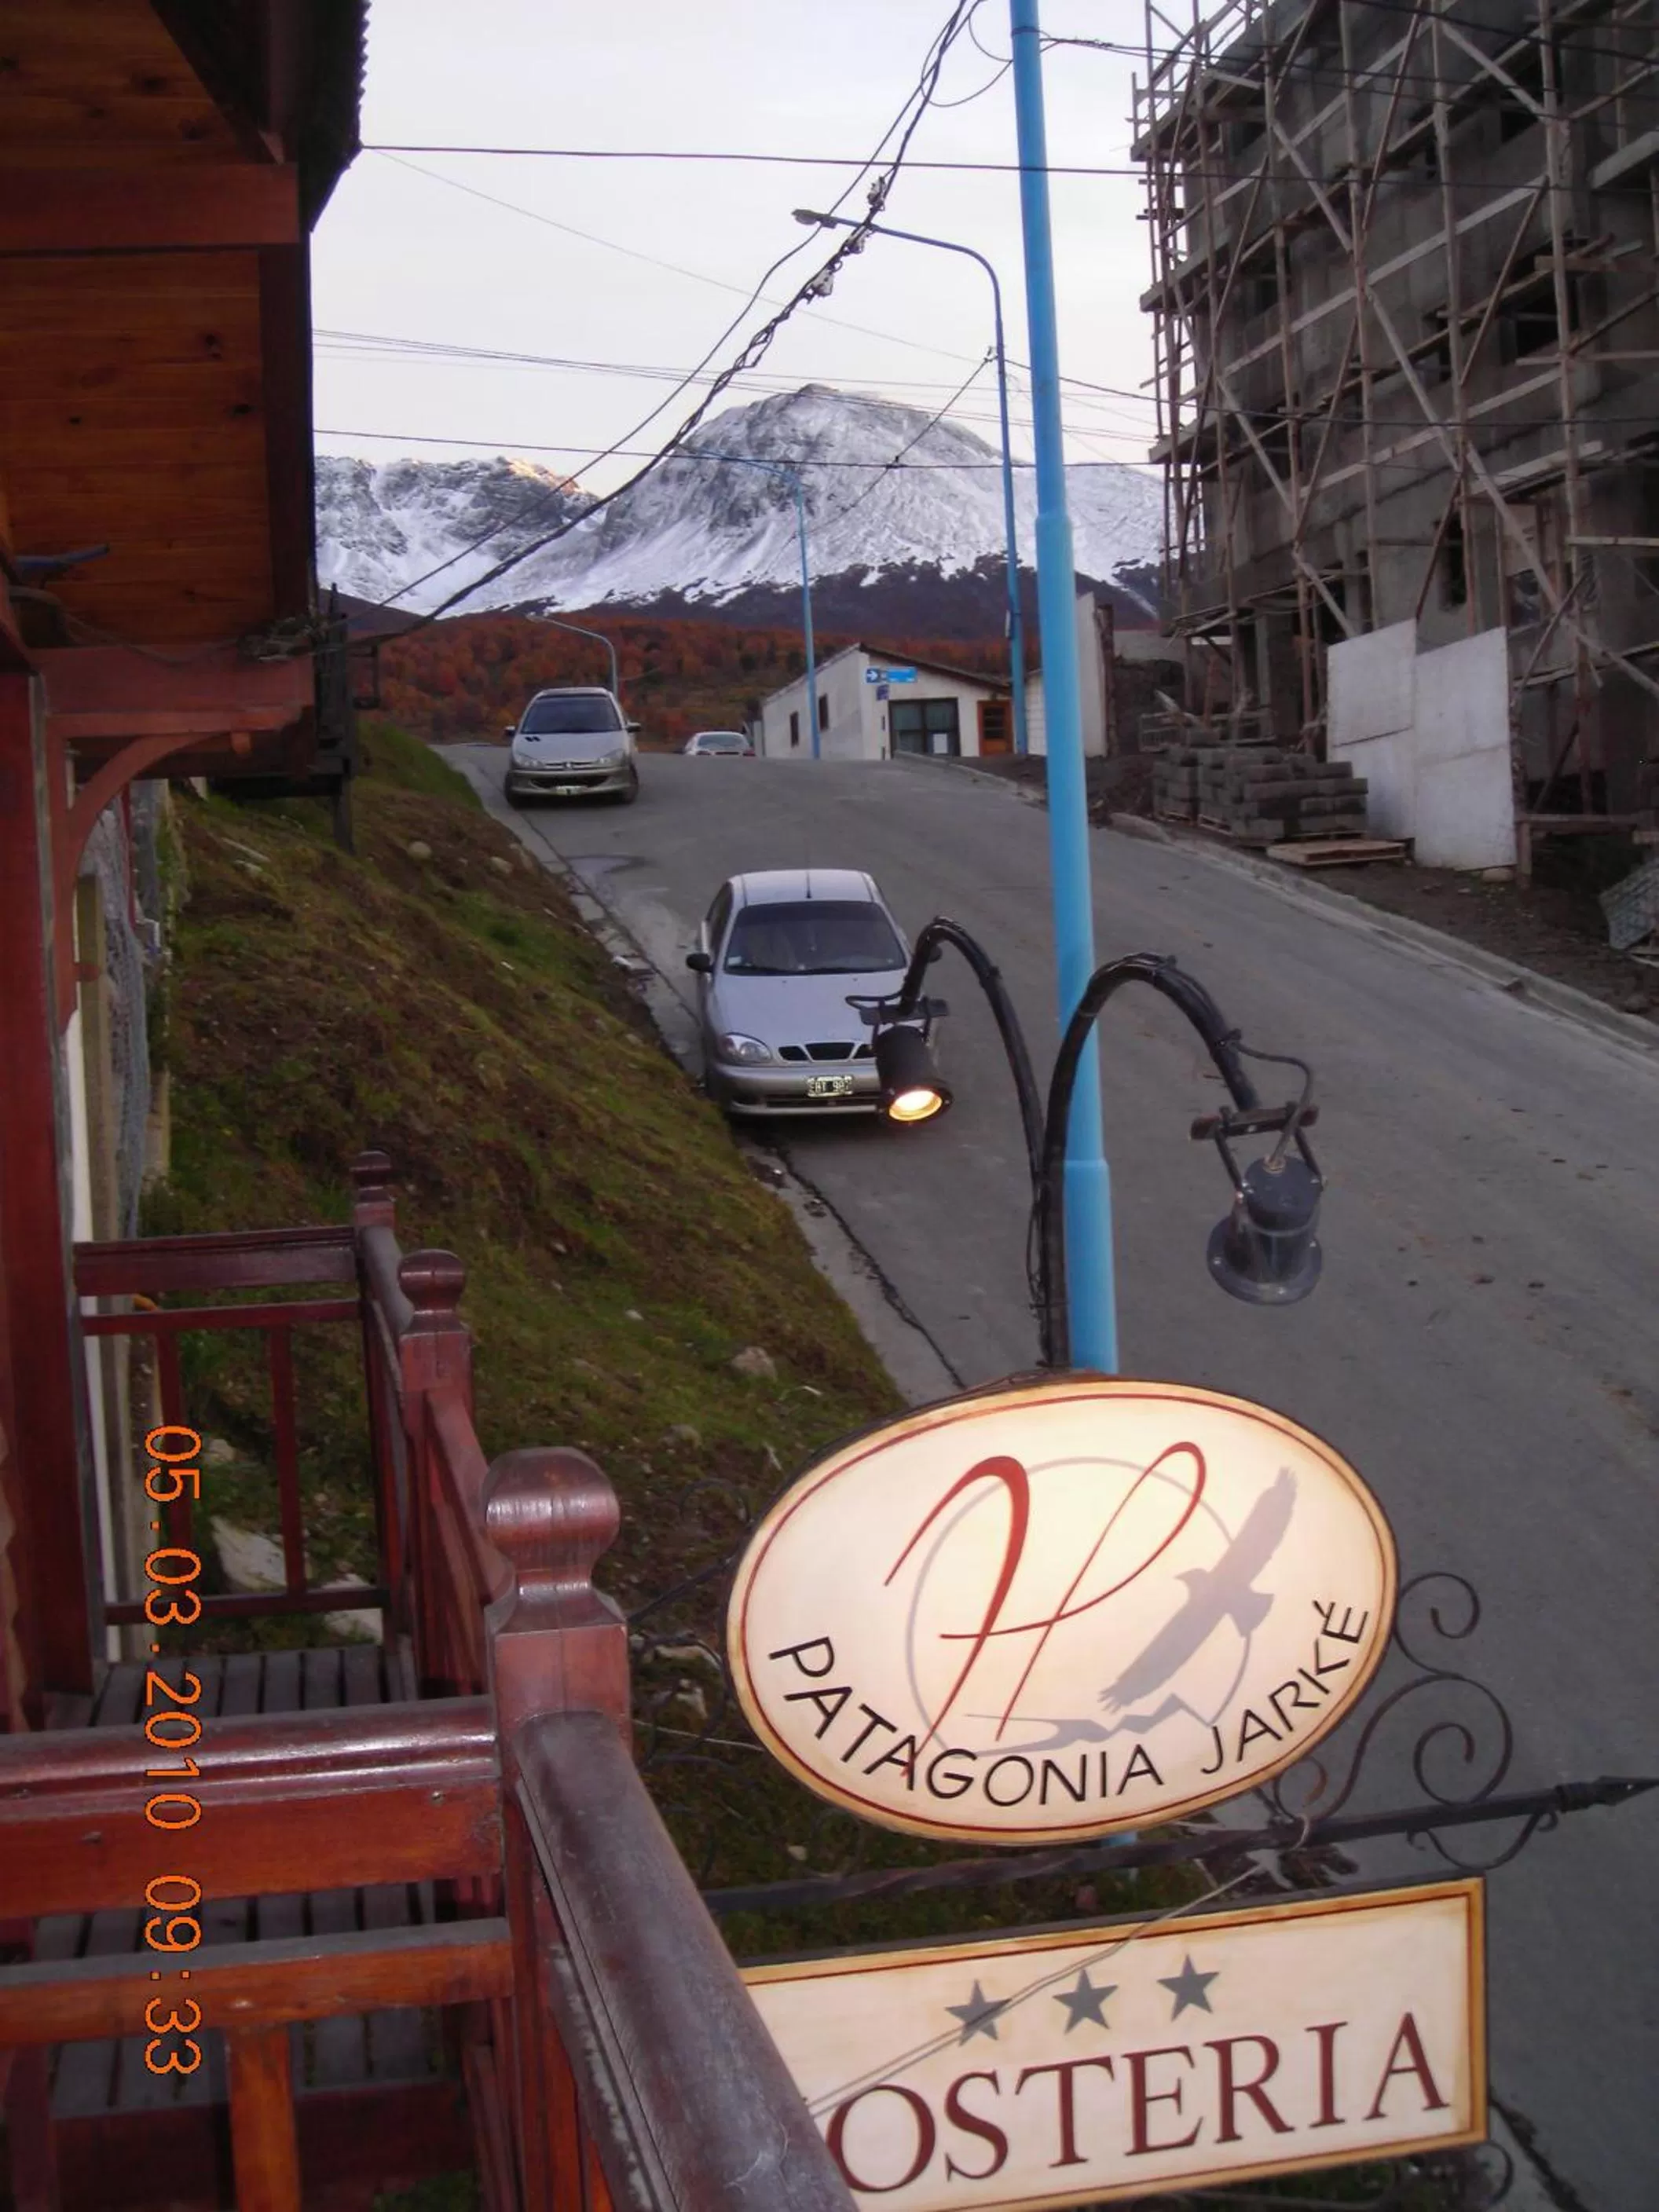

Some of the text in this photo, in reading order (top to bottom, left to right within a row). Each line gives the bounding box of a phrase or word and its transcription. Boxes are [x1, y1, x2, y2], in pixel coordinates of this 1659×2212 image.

[767, 1600, 1369, 1807] PATAGONIA JARKÉ
[825, 2011, 1451, 2193] OSTERIA
